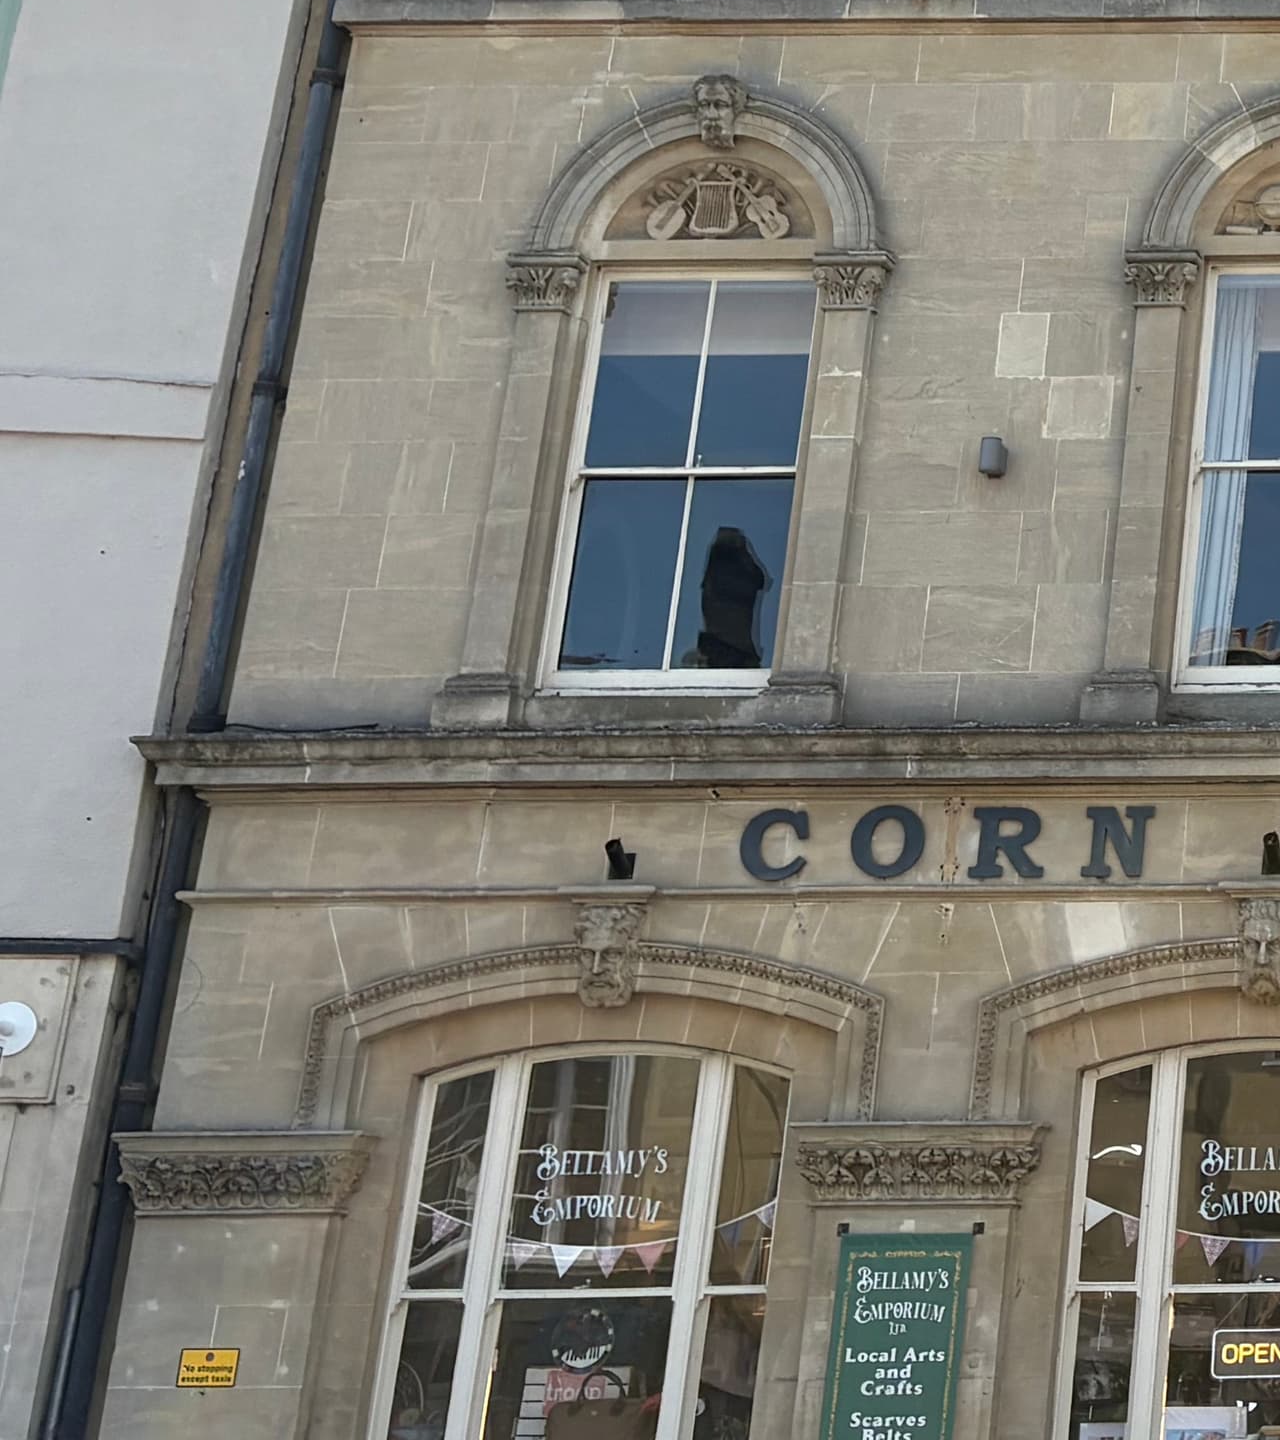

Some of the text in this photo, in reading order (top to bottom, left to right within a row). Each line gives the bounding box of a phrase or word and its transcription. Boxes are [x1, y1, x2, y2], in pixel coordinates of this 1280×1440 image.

[739, 804, 1156, 882] CORN
[529, 1186, 662, 1226] EMPORIUM
[856, 1266, 949, 1293] BELLAMY'S
[853, 1295, 946, 1324] EMPORIUM
[845, 1347, 946, 1363] Local Arts
[875, 1363, 912, 1379] and
[861, 1380, 923, 1396] Crafts
[849, 1412, 927, 1428] Scarves
